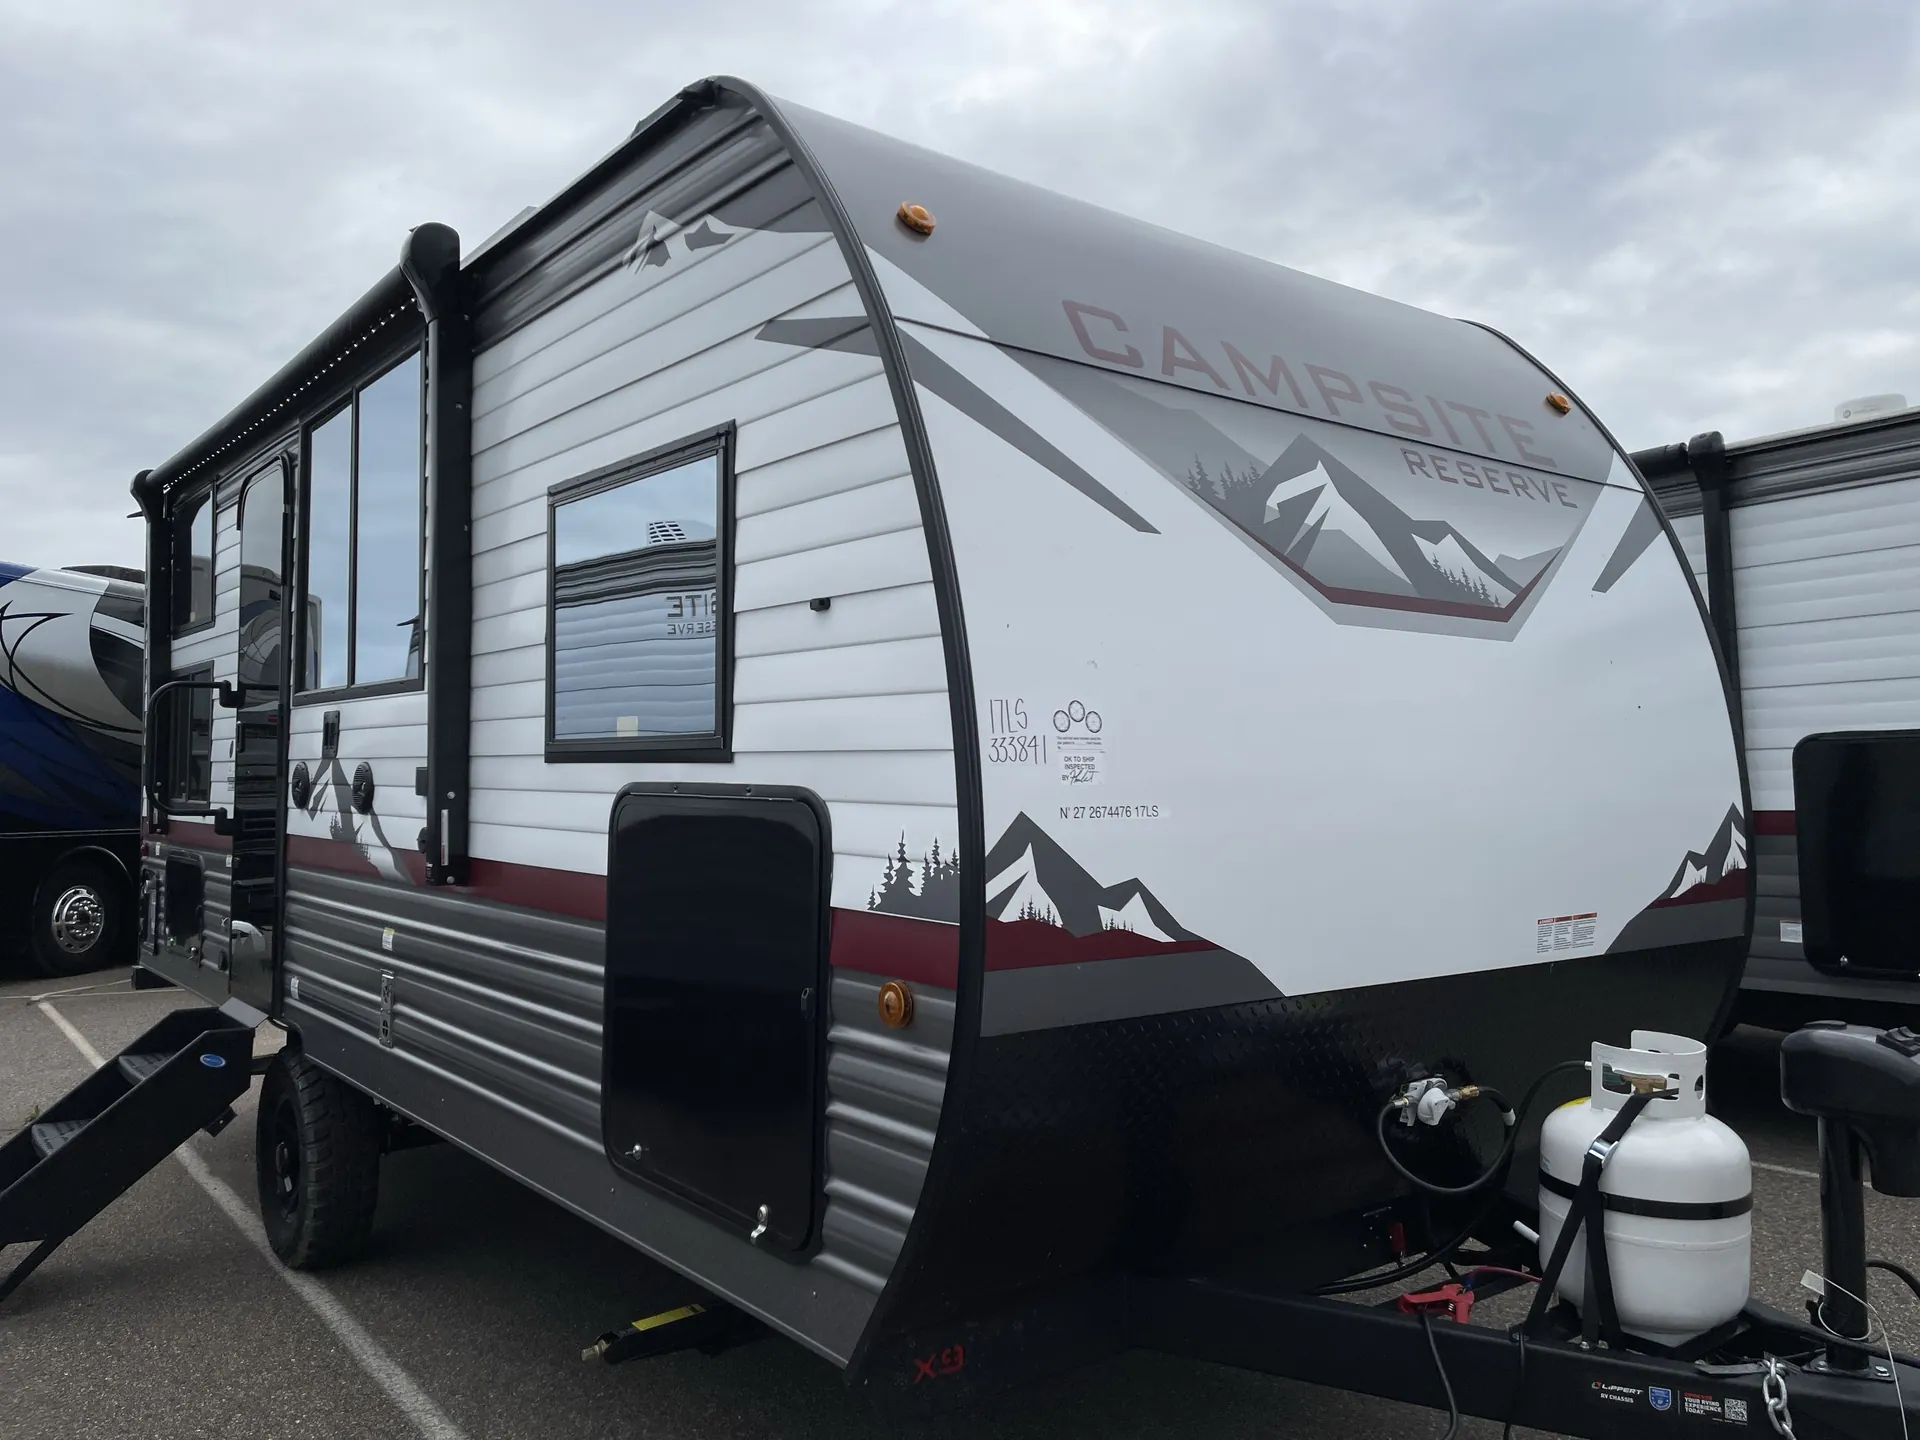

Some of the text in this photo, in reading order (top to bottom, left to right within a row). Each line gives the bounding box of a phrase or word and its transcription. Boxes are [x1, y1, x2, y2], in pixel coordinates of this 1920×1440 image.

[1062, 299, 1558, 469] CAMPSITE
[1400, 447, 1578, 509] RESERVE
[989, 698, 1028, 734] 17LS
[988, 735, 1047, 764] 333841
[1073, 806, 1085, 819] 27
[1089, 806, 1132, 819] 2674476
[1134, 805, 1159, 818] 17LS
[1609, 1394, 1634, 1403] CHASSIS
[1684, 1402, 1722, 1413] EXPERIENCE
